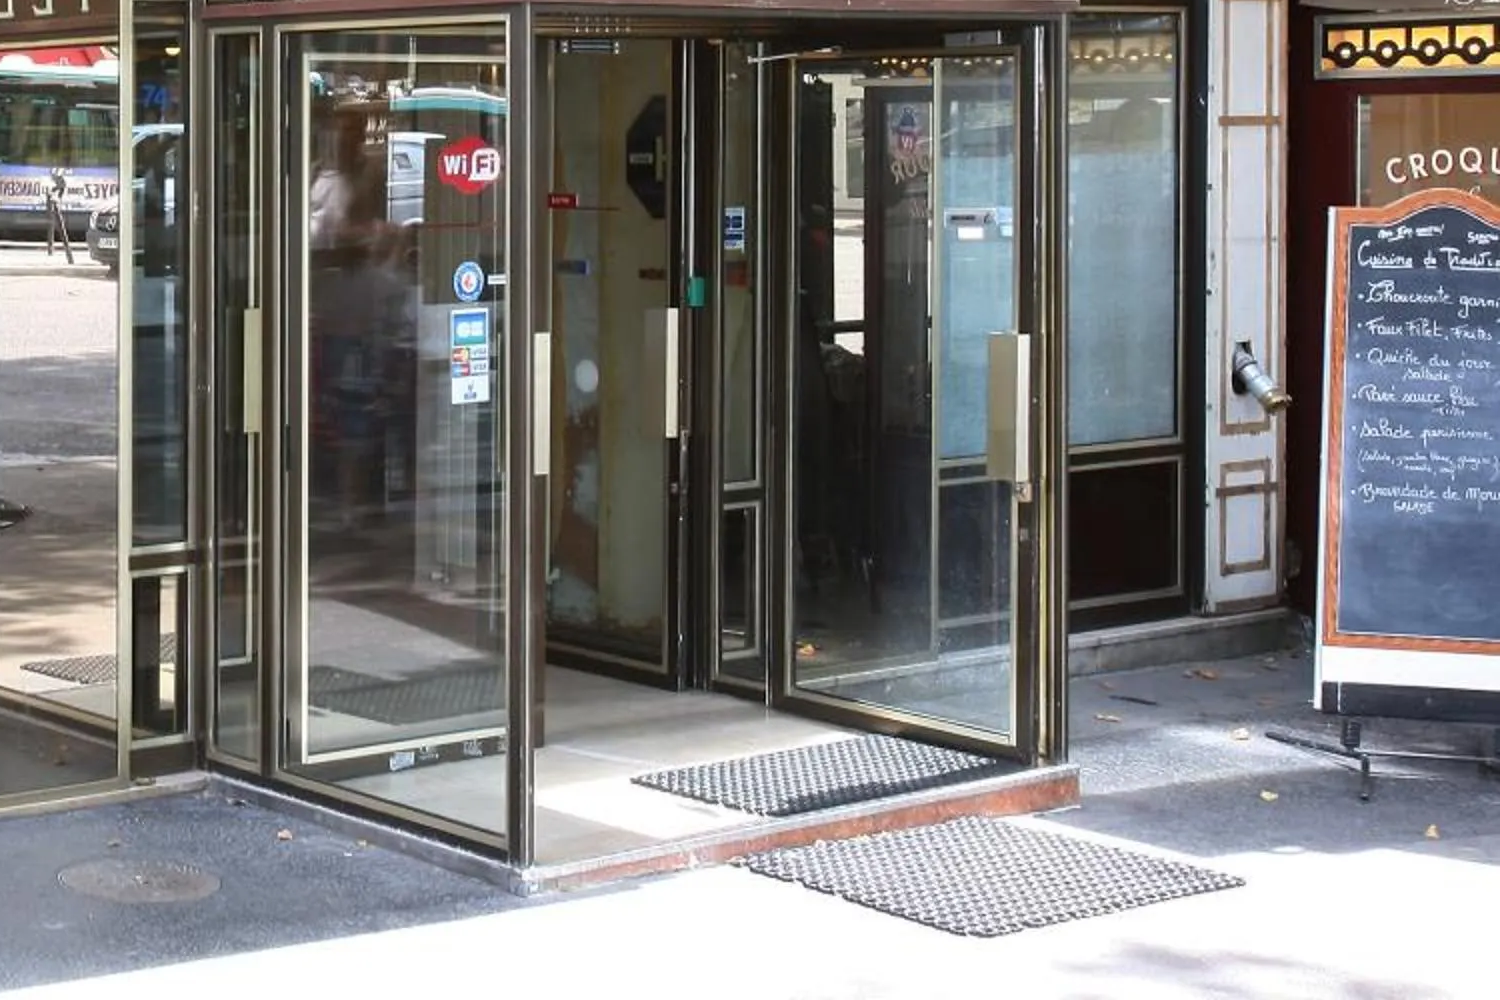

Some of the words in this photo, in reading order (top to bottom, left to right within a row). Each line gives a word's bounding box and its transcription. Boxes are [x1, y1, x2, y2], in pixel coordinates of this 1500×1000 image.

[443, 153, 498, 176] WiFi
[1367, 348, 1420, 366] Quiche
[1429, 353, 1451, 367] du
